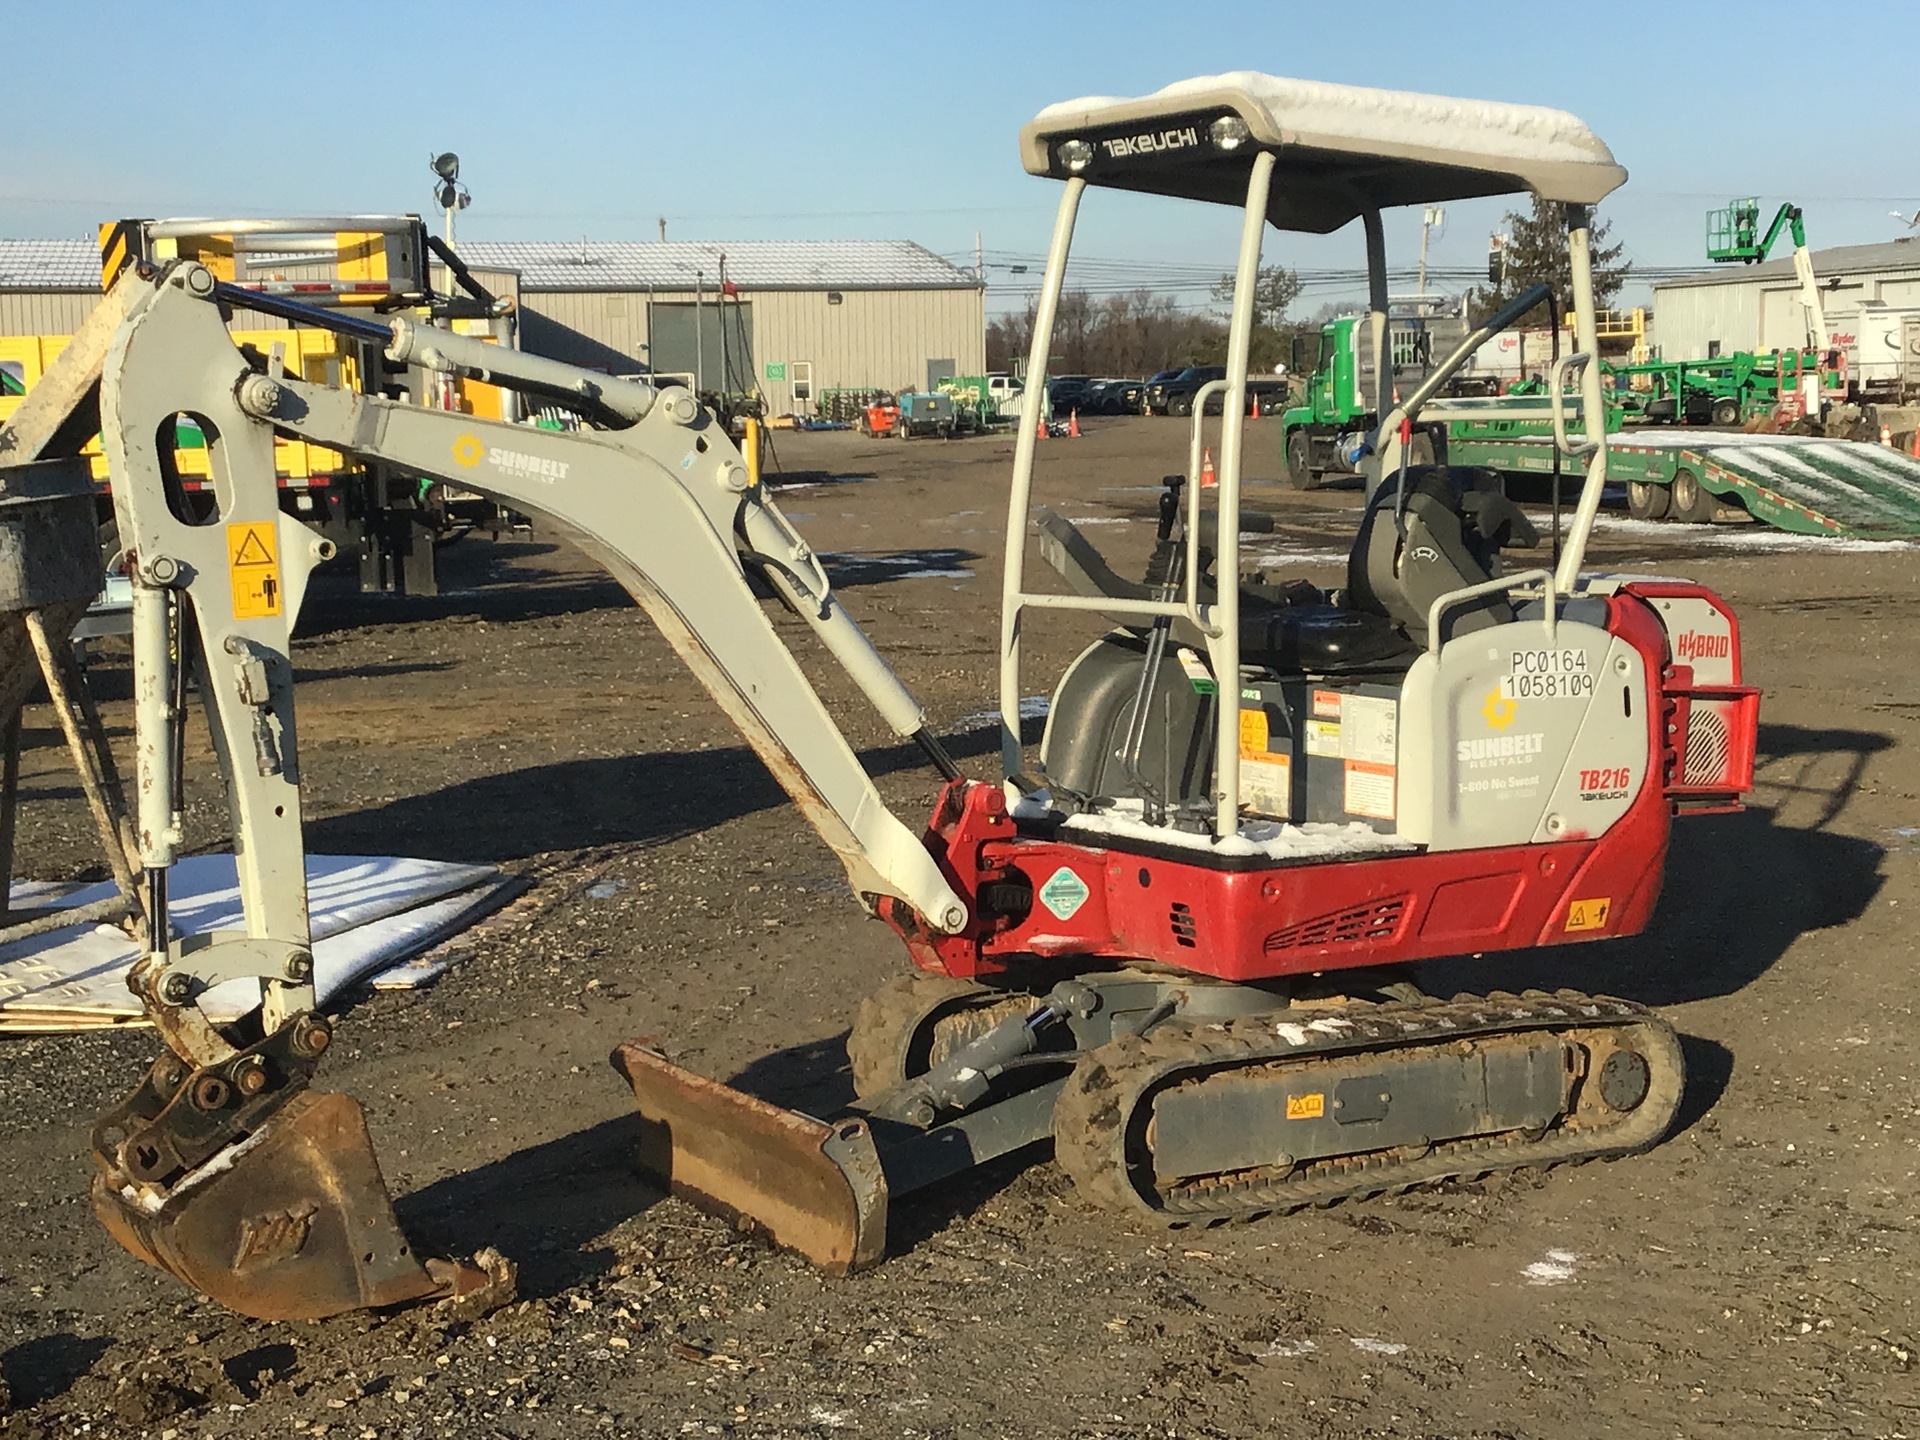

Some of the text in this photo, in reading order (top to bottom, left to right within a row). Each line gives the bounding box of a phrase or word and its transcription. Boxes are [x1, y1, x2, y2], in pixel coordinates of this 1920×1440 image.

[488, 447, 569, 479] SUNBELT
[1677, 629, 1729, 662] HYBRID
[1512, 650, 1586, 674] PC0164
[1507, 674, 1593, 697] 1058109
[1457, 733, 1544, 761] SUNBELT
[1469, 754, 1533, 769] RENTALS
[1458, 780, 1489, 793] 1-800
[1491, 779, 1506, 789] No
[1579, 768, 1630, 791] TB216
